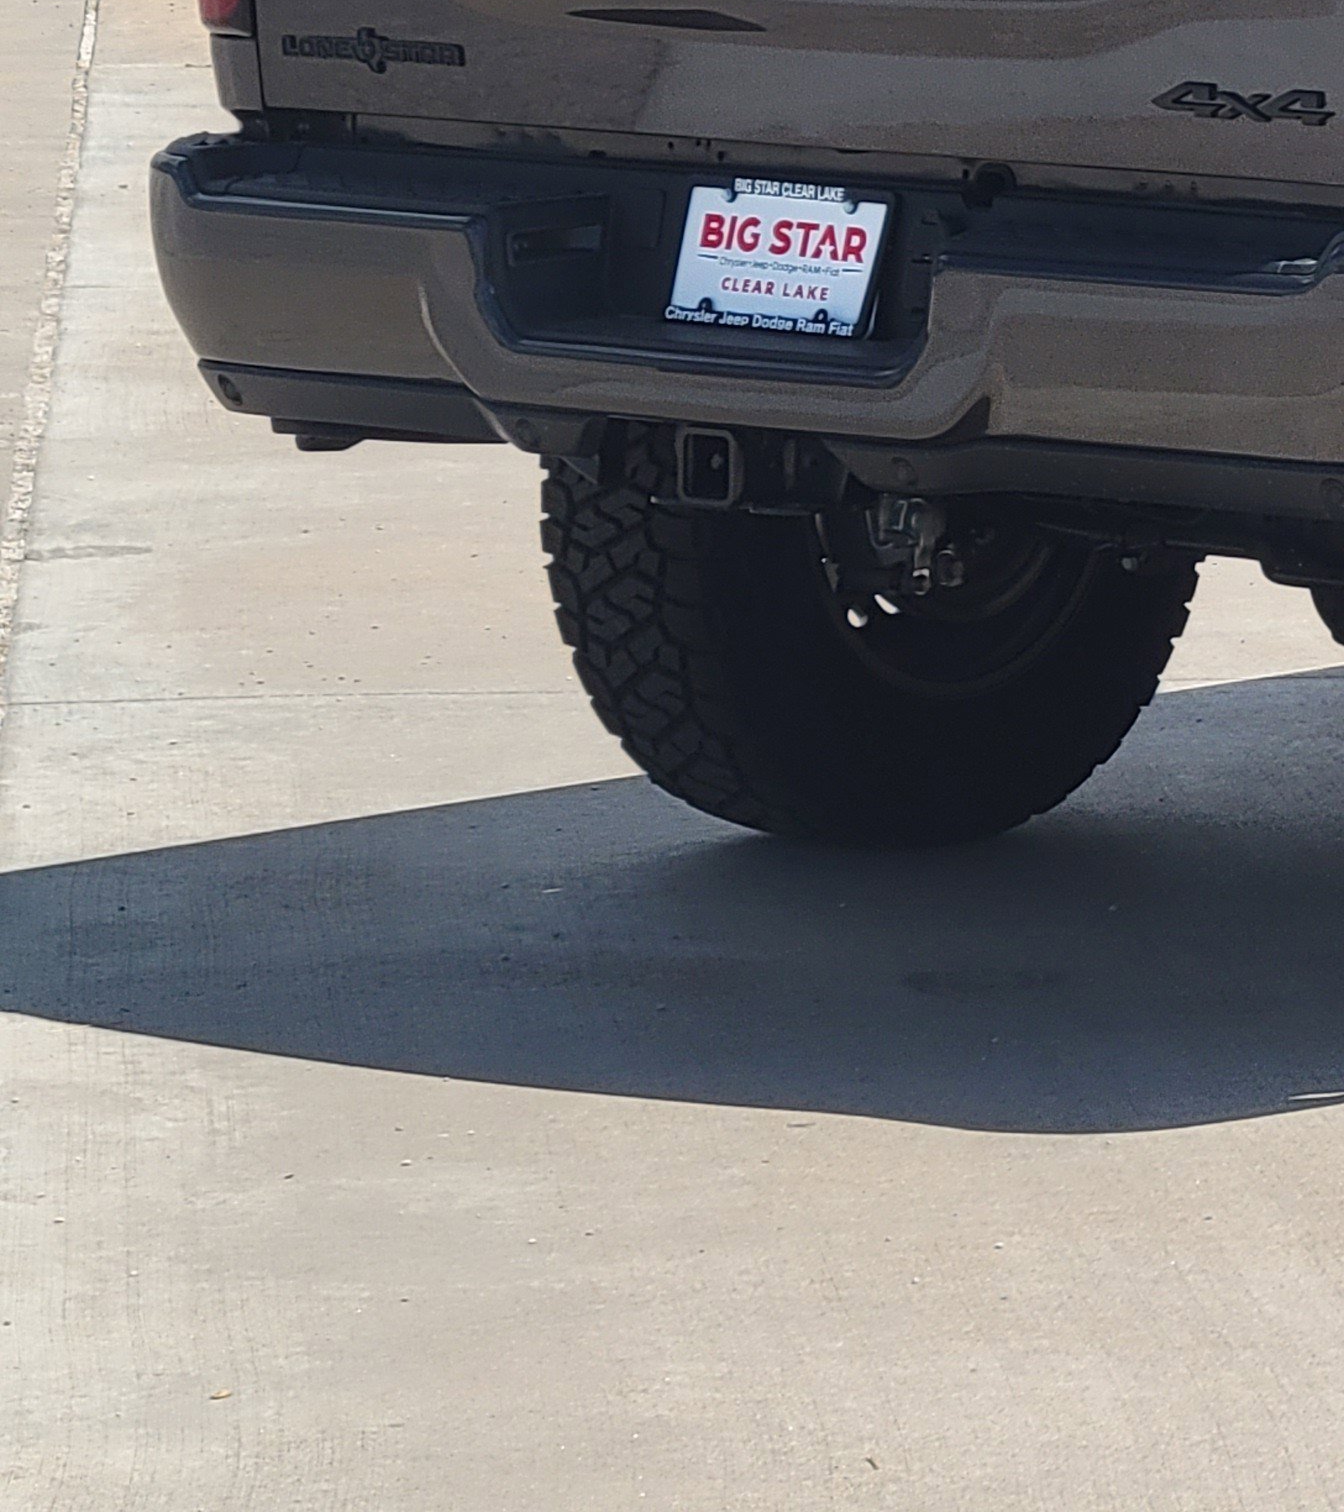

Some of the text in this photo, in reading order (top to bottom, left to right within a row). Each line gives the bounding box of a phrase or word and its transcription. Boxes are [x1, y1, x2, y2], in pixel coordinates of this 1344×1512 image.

[282, 35, 466, 67] LONE STAR
[735, 178, 845, 201] BIG STAR CLEAR LAKE
[699, 213, 867, 263] BIG STAR
[721, 277, 829, 301] CLEAR LAKE
[664, 306, 854, 336] Chrysler Jeep Dodge Ram Fiat
